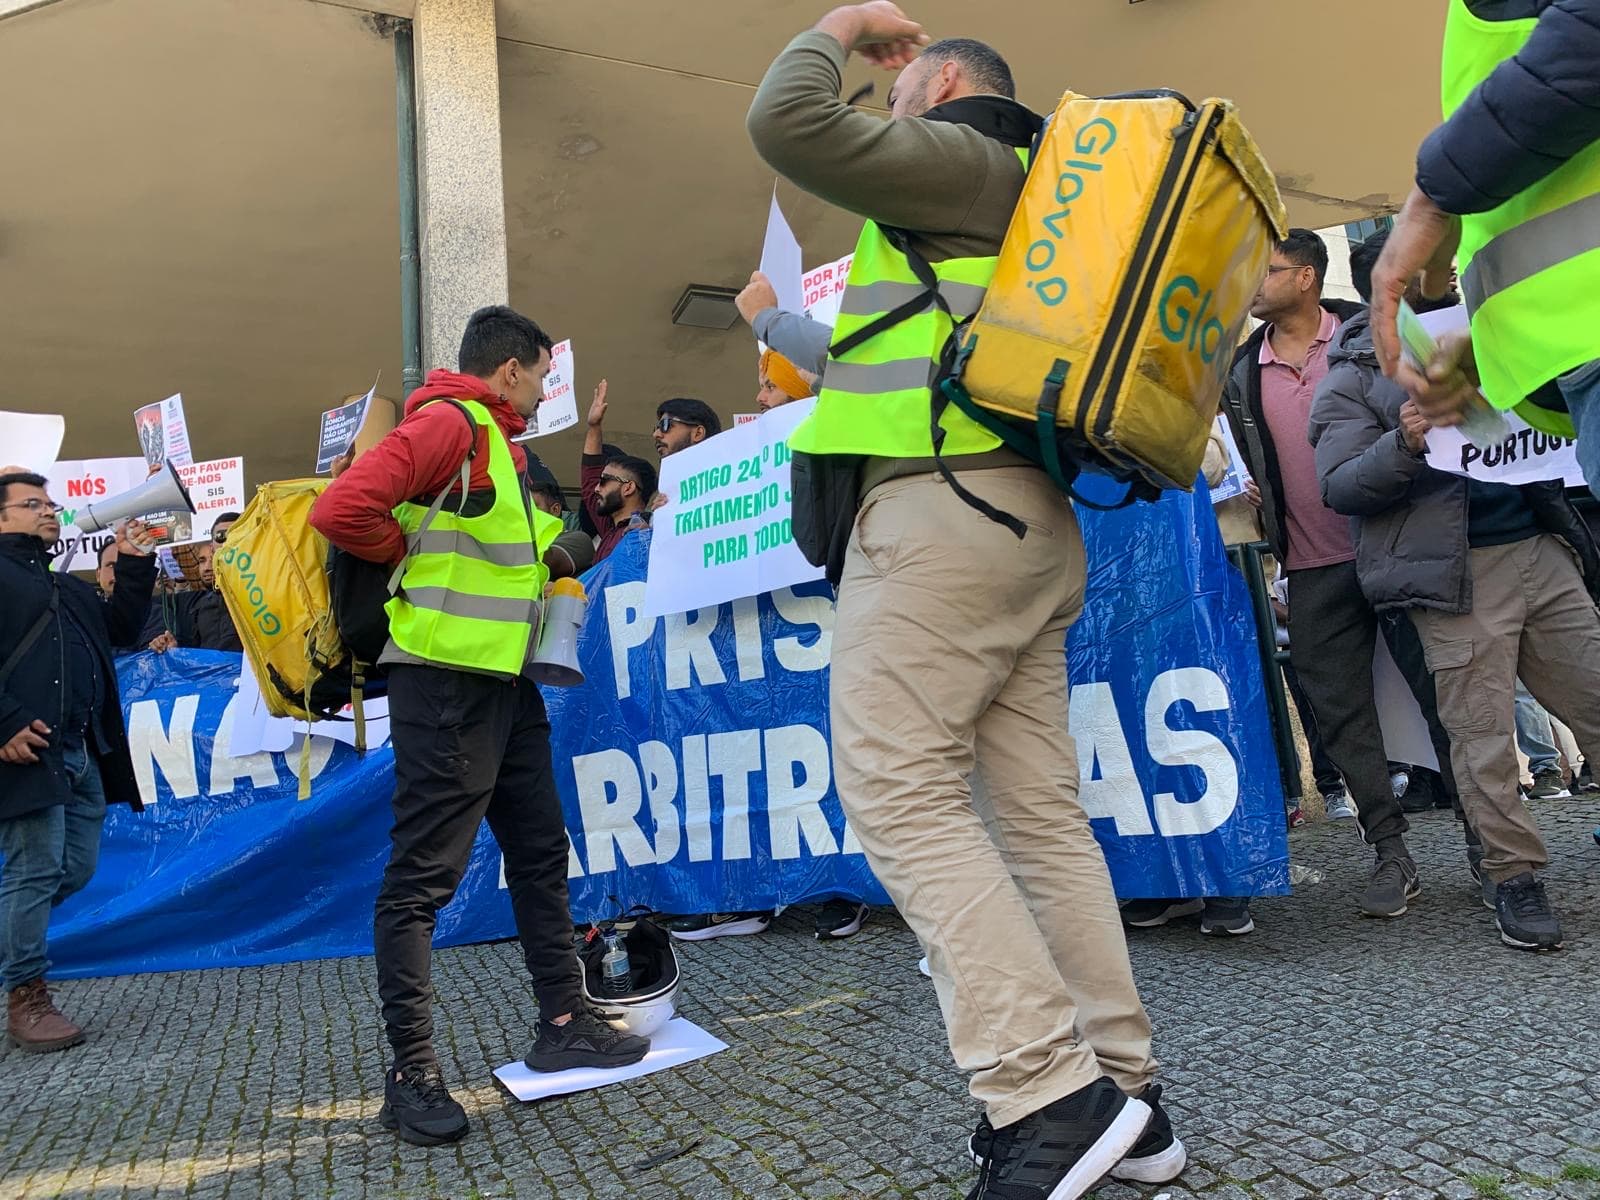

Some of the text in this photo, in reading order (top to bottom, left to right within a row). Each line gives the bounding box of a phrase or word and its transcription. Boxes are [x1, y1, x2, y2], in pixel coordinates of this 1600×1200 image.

[803, 269, 833, 291] POR
[549, 374, 561, 387] SIS
[543, 383, 570, 402] ALERTA
[548, 414, 572, 428] JUSTIÇA
[199, 460, 237, 473] FAVOR
[67, 473, 107, 497] NÓS
[207, 487, 225, 497] SIS
[680, 464, 732, 505] ARTIGO
[197, 497, 237, 511] ALERTA
[674, 482, 779, 537] TRATAMENTO
[703, 534, 748, 568] PARA
